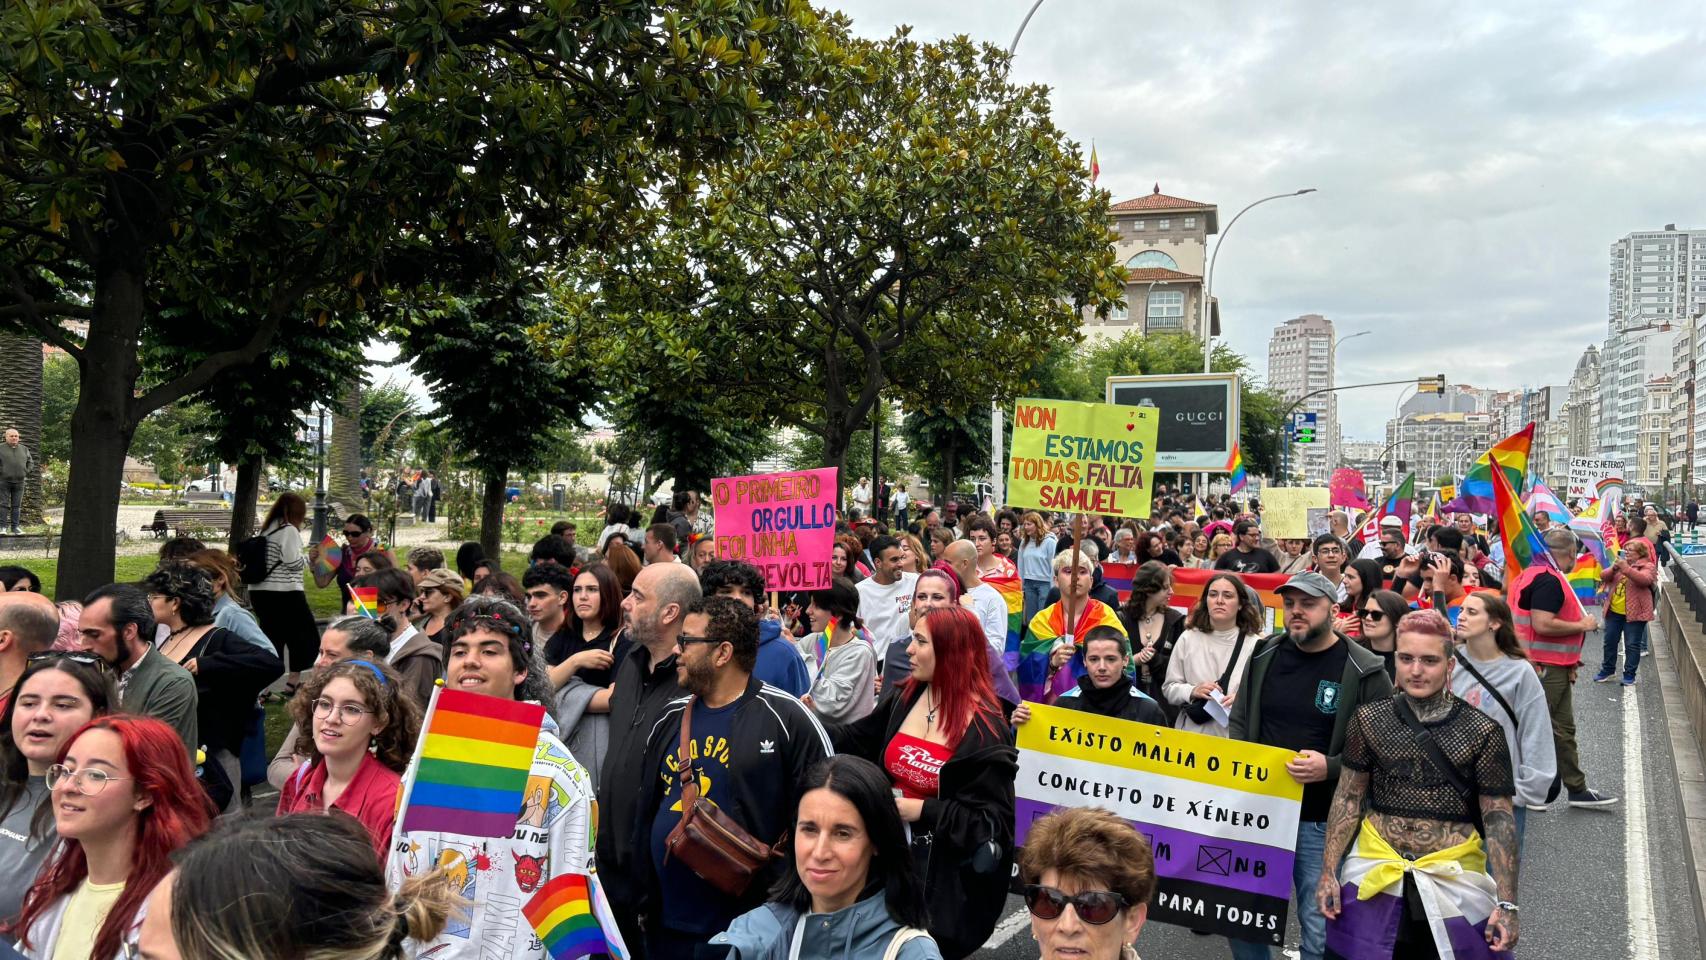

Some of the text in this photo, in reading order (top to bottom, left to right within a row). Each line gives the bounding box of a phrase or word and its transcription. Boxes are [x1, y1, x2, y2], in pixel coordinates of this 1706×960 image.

[1016, 405, 1057, 430] NON
[1175, 411, 1223, 421] GUCCI
[1295, 414, 1306, 426] P
[1045, 434, 1143, 463] ESTAMOS
[1571, 458, 1599, 468] ¿ERES
[1011, 457, 1143, 489] TODAS, FALTA
[715, 474, 820, 505] O PRIMEIRO
[1039, 485, 1123, 514] SAMUEL
[1570, 486, 1585, 494] NAD
[752, 503, 834, 532] ORGULLO
[717, 531, 798, 560] FOI UNHA
[1207, 756, 1220, 772] O
[1231, 760, 1269, 782] TEU
[1038, 770, 1270, 830] CONCEPTO DE XÉNERO
[1155, 841, 1171, 861] M
[1159, 892, 1278, 930] PARA TODES
